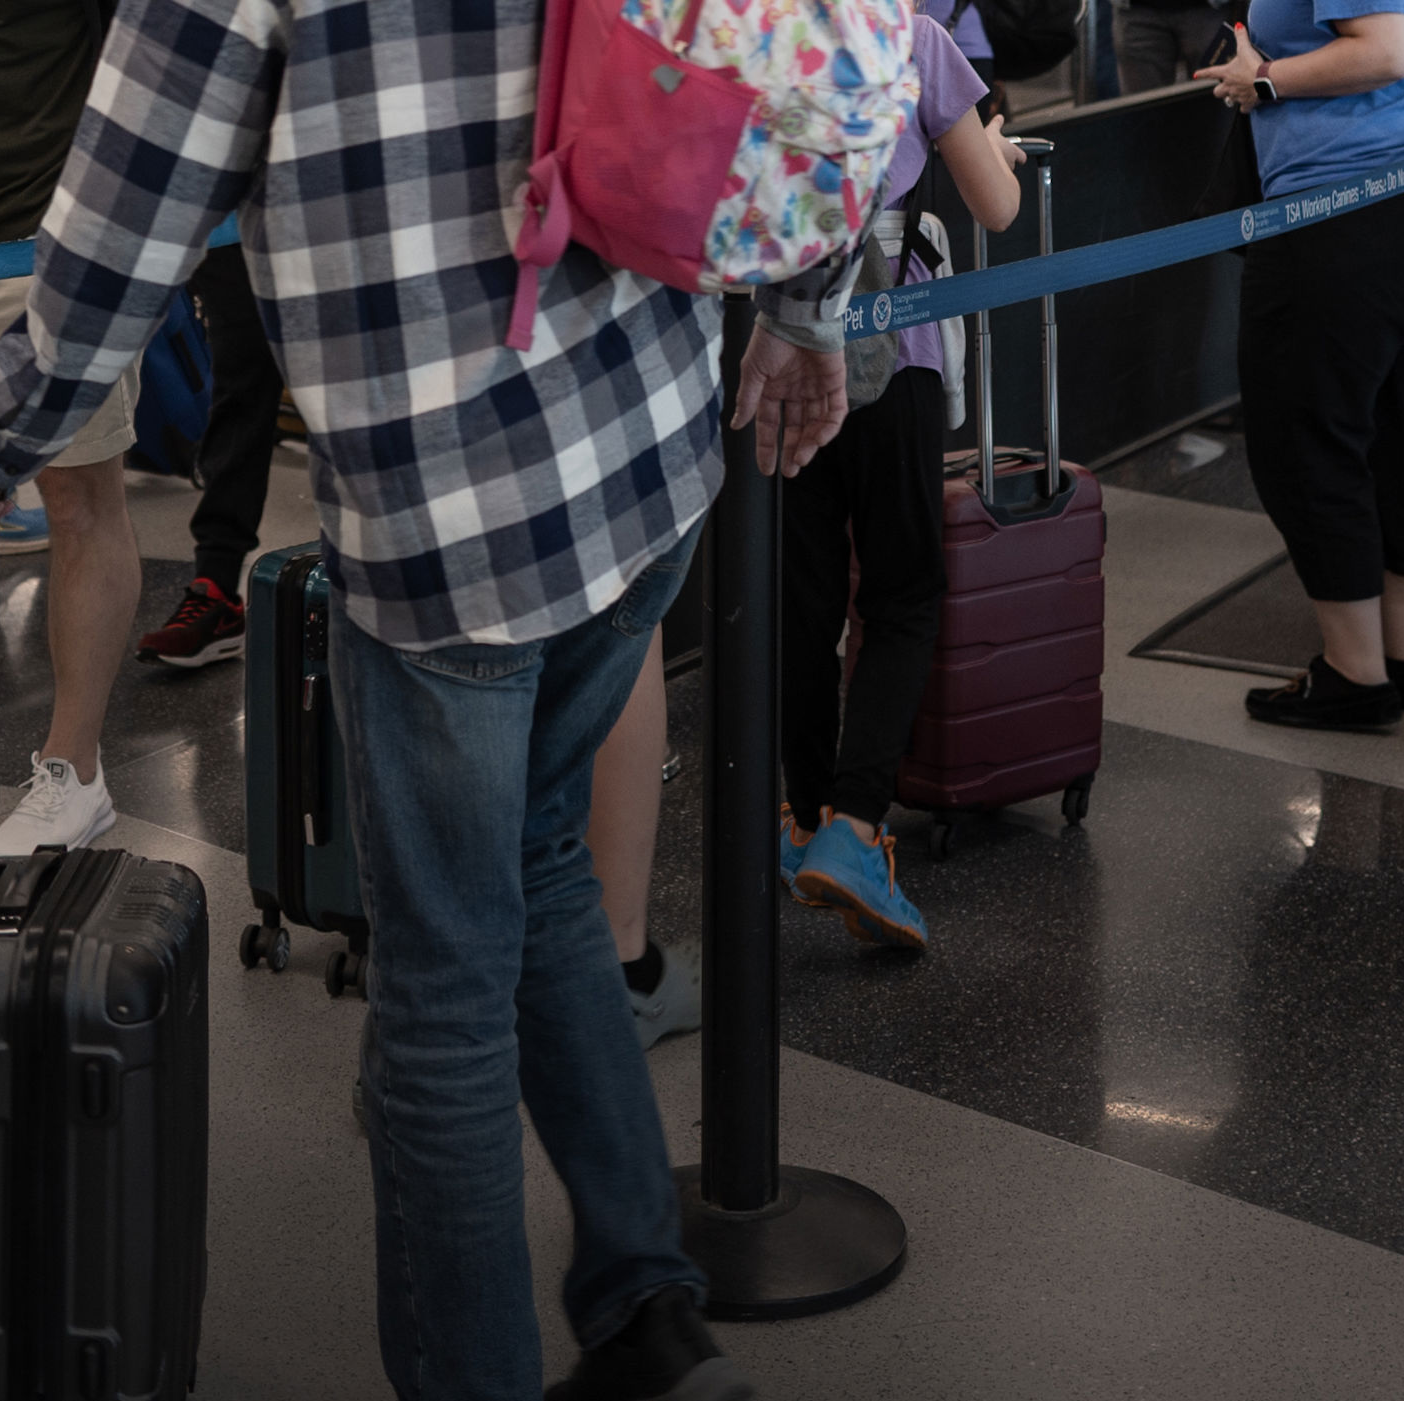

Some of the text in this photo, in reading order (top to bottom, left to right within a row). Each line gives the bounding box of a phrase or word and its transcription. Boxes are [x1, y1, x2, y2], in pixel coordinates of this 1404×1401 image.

[1285, 201, 1301, 225] TSA
[1301, 195, 1331, 217] Working
[1332, 186, 1359, 210] Canines
[1365, 178, 1387, 199] Please
[1387, 171, 1397, 192] Do
[844, 305, 864, 332] Pet
